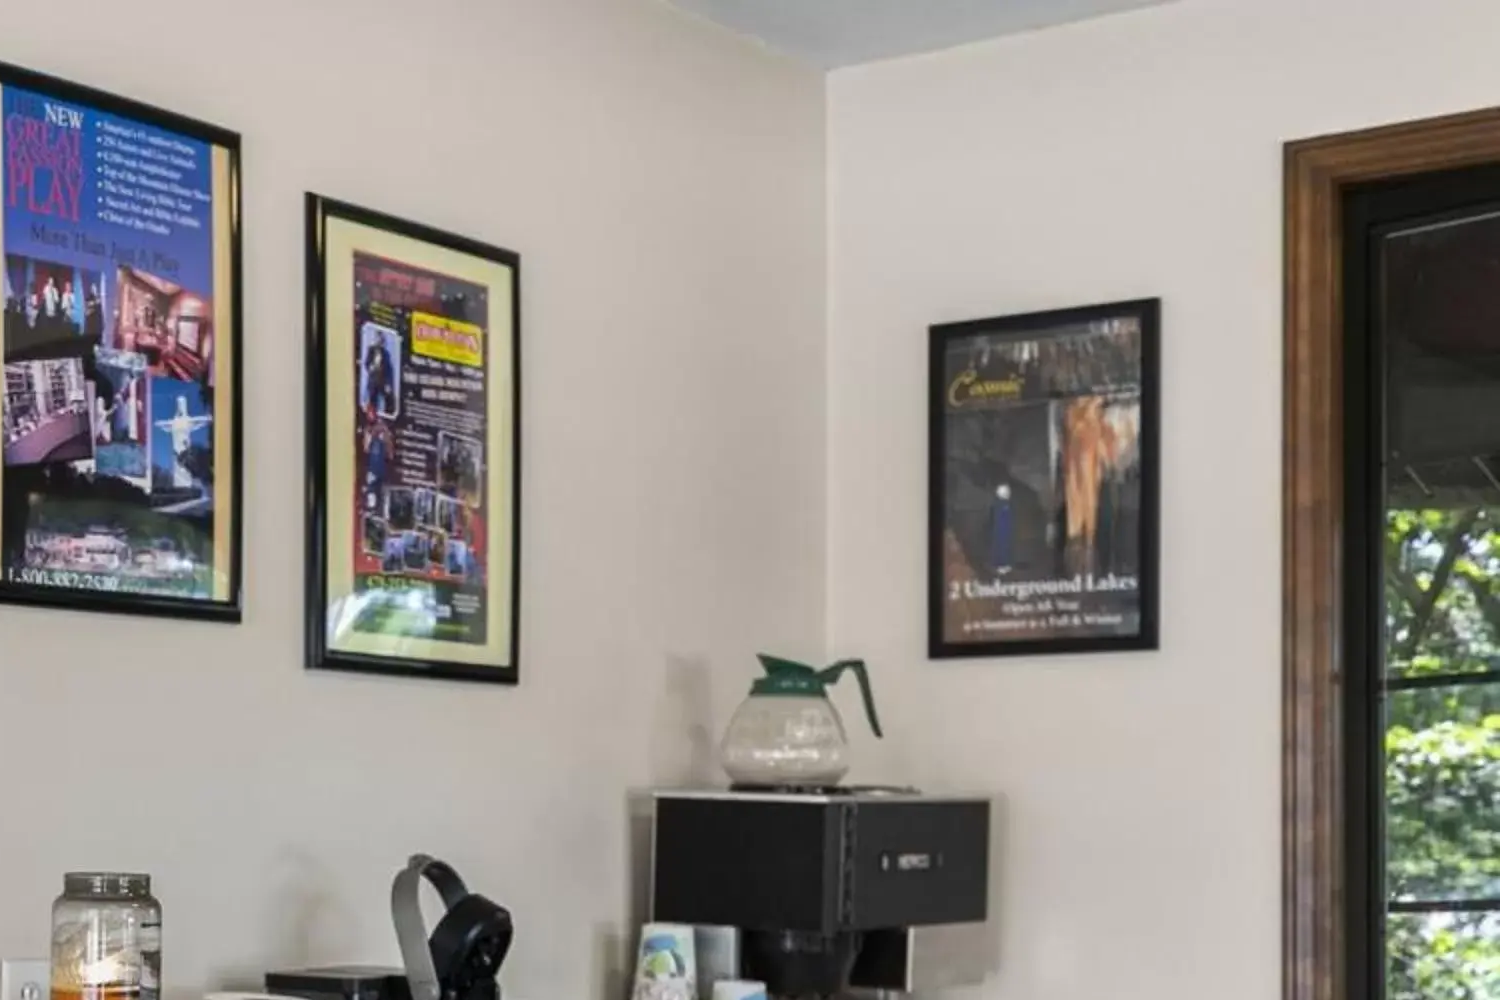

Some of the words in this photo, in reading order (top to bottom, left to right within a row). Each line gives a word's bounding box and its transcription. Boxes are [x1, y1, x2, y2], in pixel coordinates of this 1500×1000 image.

[44, 102, 85, 129] NEW
[8, 158, 83, 223] PLAY
[30, 224, 69, 249] More
[75, 231, 106, 254] Than
[950, 581, 961, 600] 2
[964, 573, 1082, 601] Underground
[1085, 571, 1138, 592] Lakes
[1002, 602, 1034, 617] Open
[1037, 599, 1053, 612] All
[1056, 600, 1080, 611] Year
[1084, 612, 1123, 625] Winter
